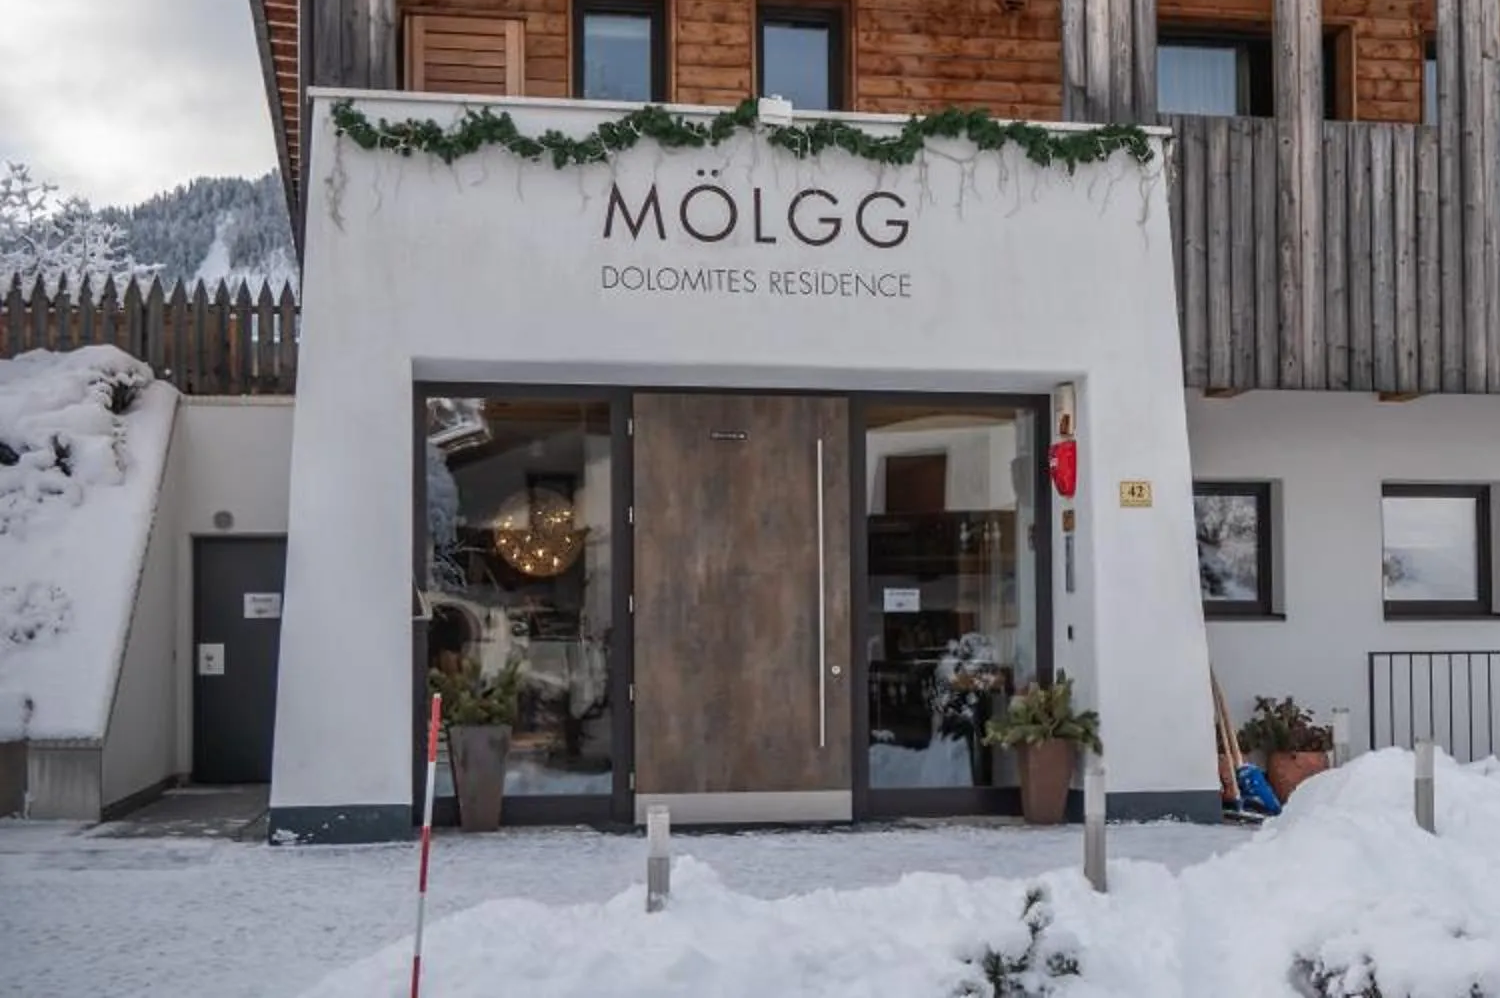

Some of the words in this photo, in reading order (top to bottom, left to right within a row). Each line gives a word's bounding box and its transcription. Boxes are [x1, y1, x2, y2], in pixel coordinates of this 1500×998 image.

[603, 169, 909, 249] MÖLGG
[602, 265, 757, 294] DOLOMITES
[769, 271, 912, 298] RESIDENCE
[1127, 485, 1145, 499] 42
